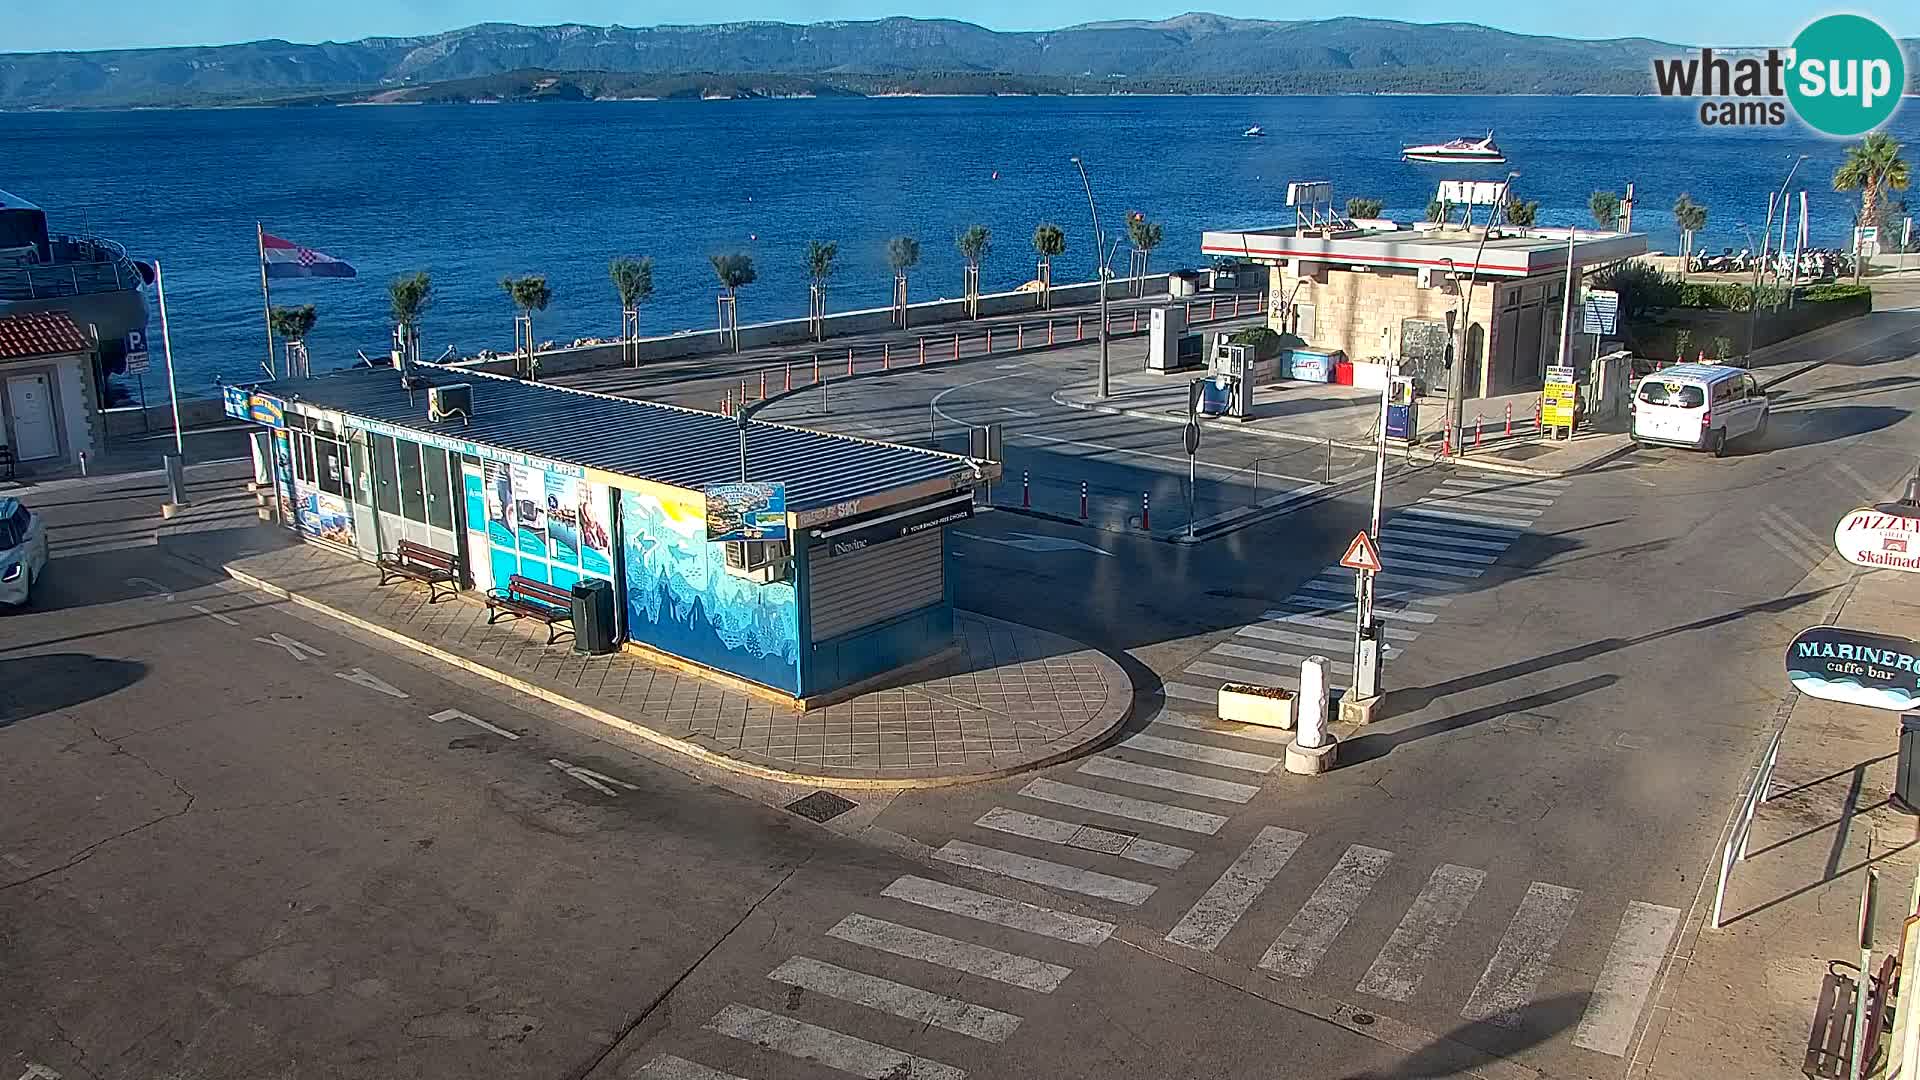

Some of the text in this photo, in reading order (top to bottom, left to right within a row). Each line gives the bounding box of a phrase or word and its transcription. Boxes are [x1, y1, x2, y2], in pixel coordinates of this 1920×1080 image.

[129, 332, 142, 350] P
[1826, 662, 1895, 680] caffe bar
